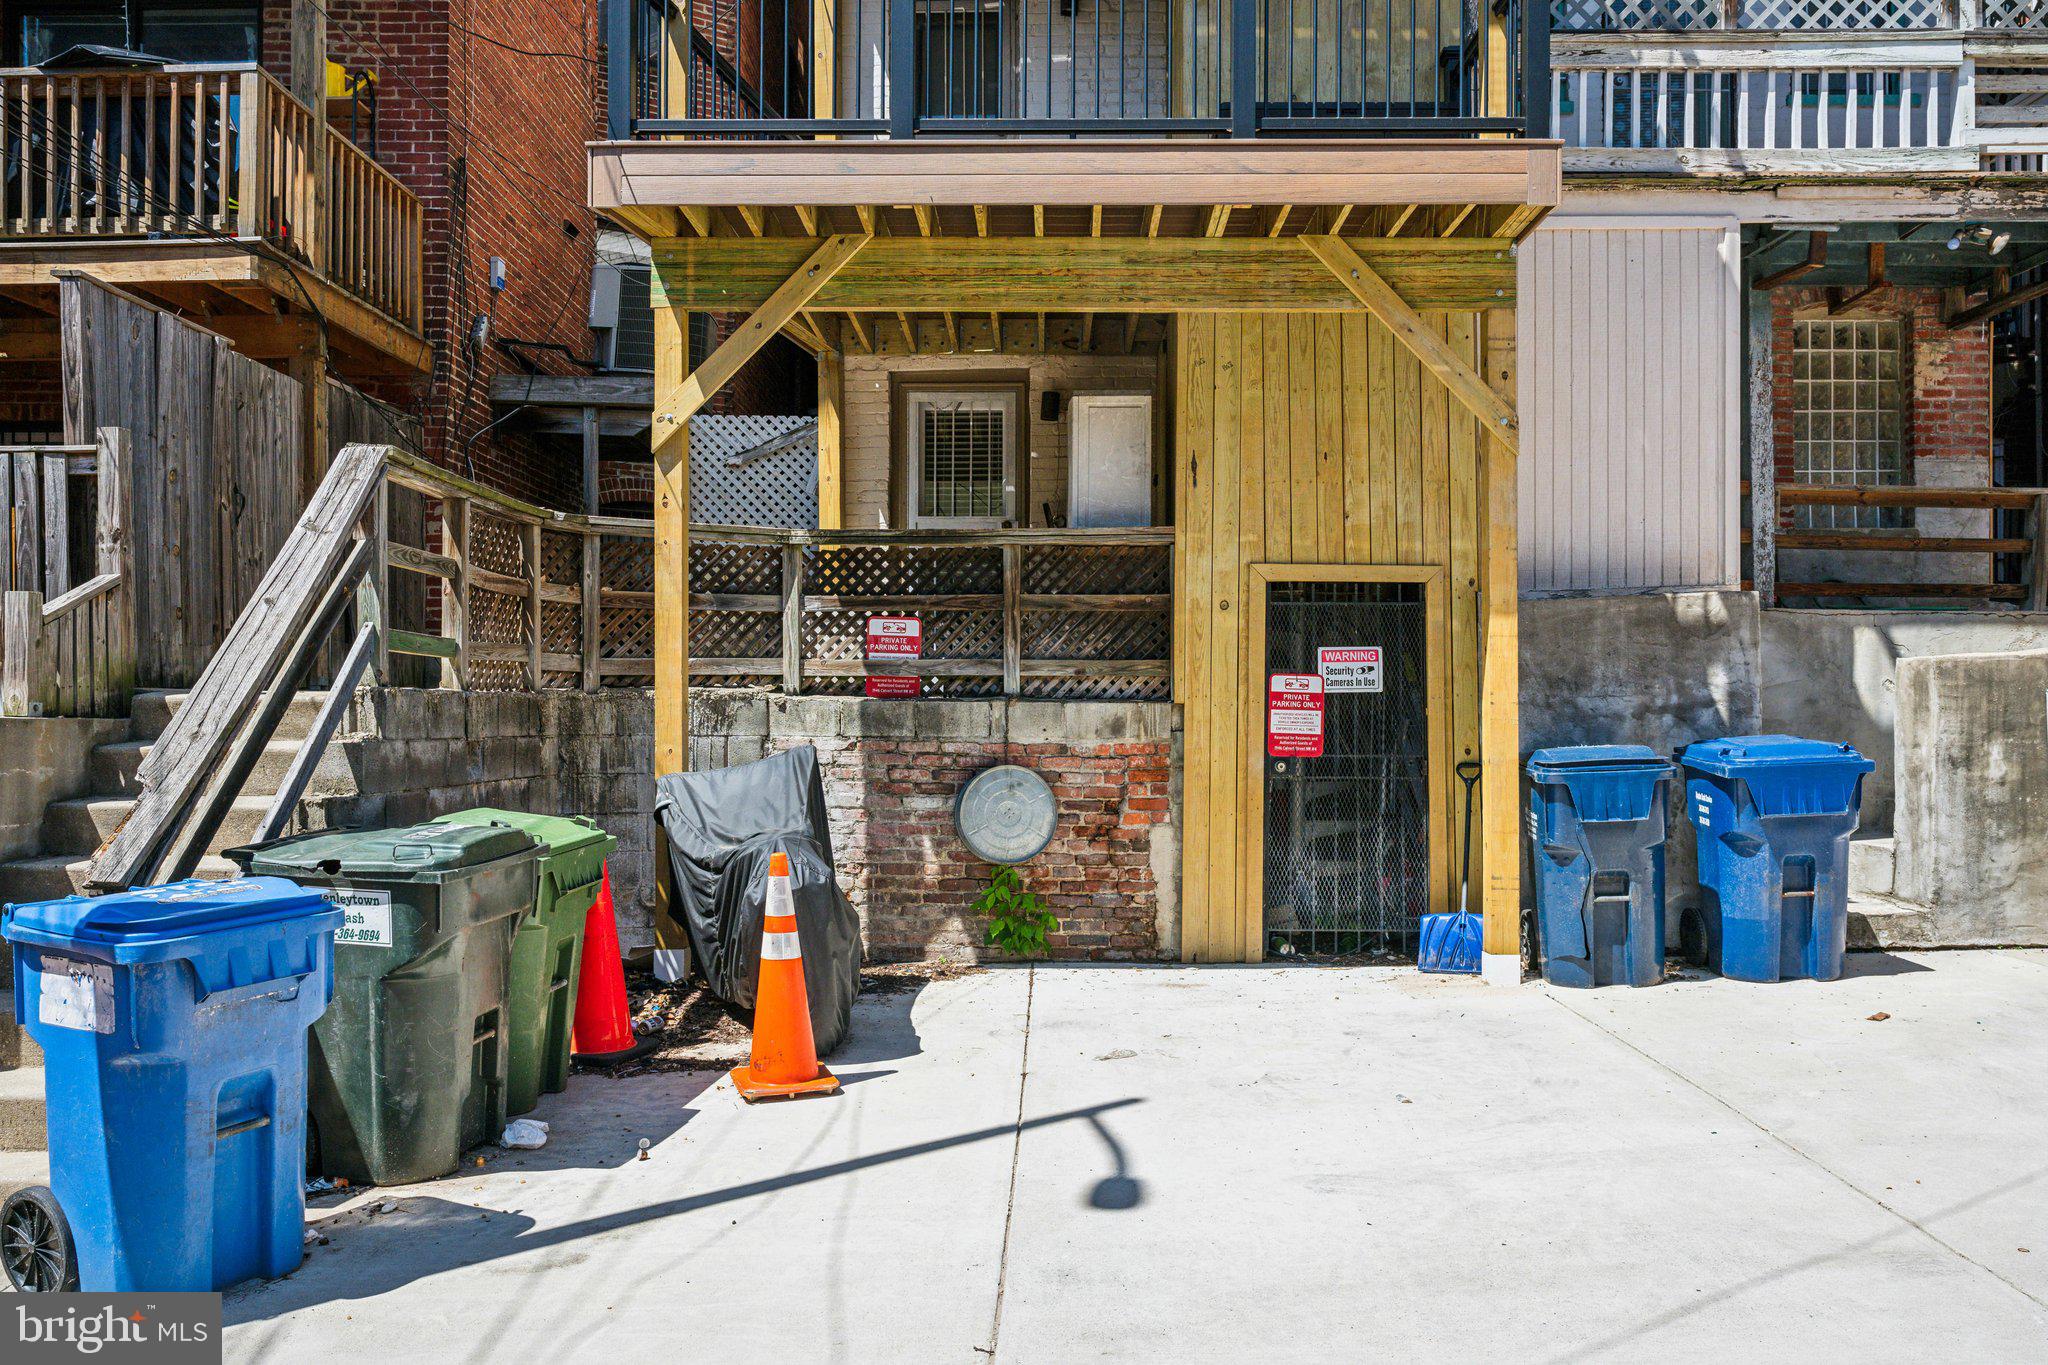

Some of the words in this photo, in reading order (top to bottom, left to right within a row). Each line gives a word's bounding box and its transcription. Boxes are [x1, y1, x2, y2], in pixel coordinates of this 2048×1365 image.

[1325, 652, 1376, 661] WARNING
[1326, 666, 1354, 676] Security
[1326, 678, 1354, 686] Cameras
[1356, 678, 1362, 686] In
[1364, 677, 1376, 686] Use
[322, 892, 380, 907] enleytown
[346, 912, 365, 924] ash
[335, 928, 380, 941] -364-9694
